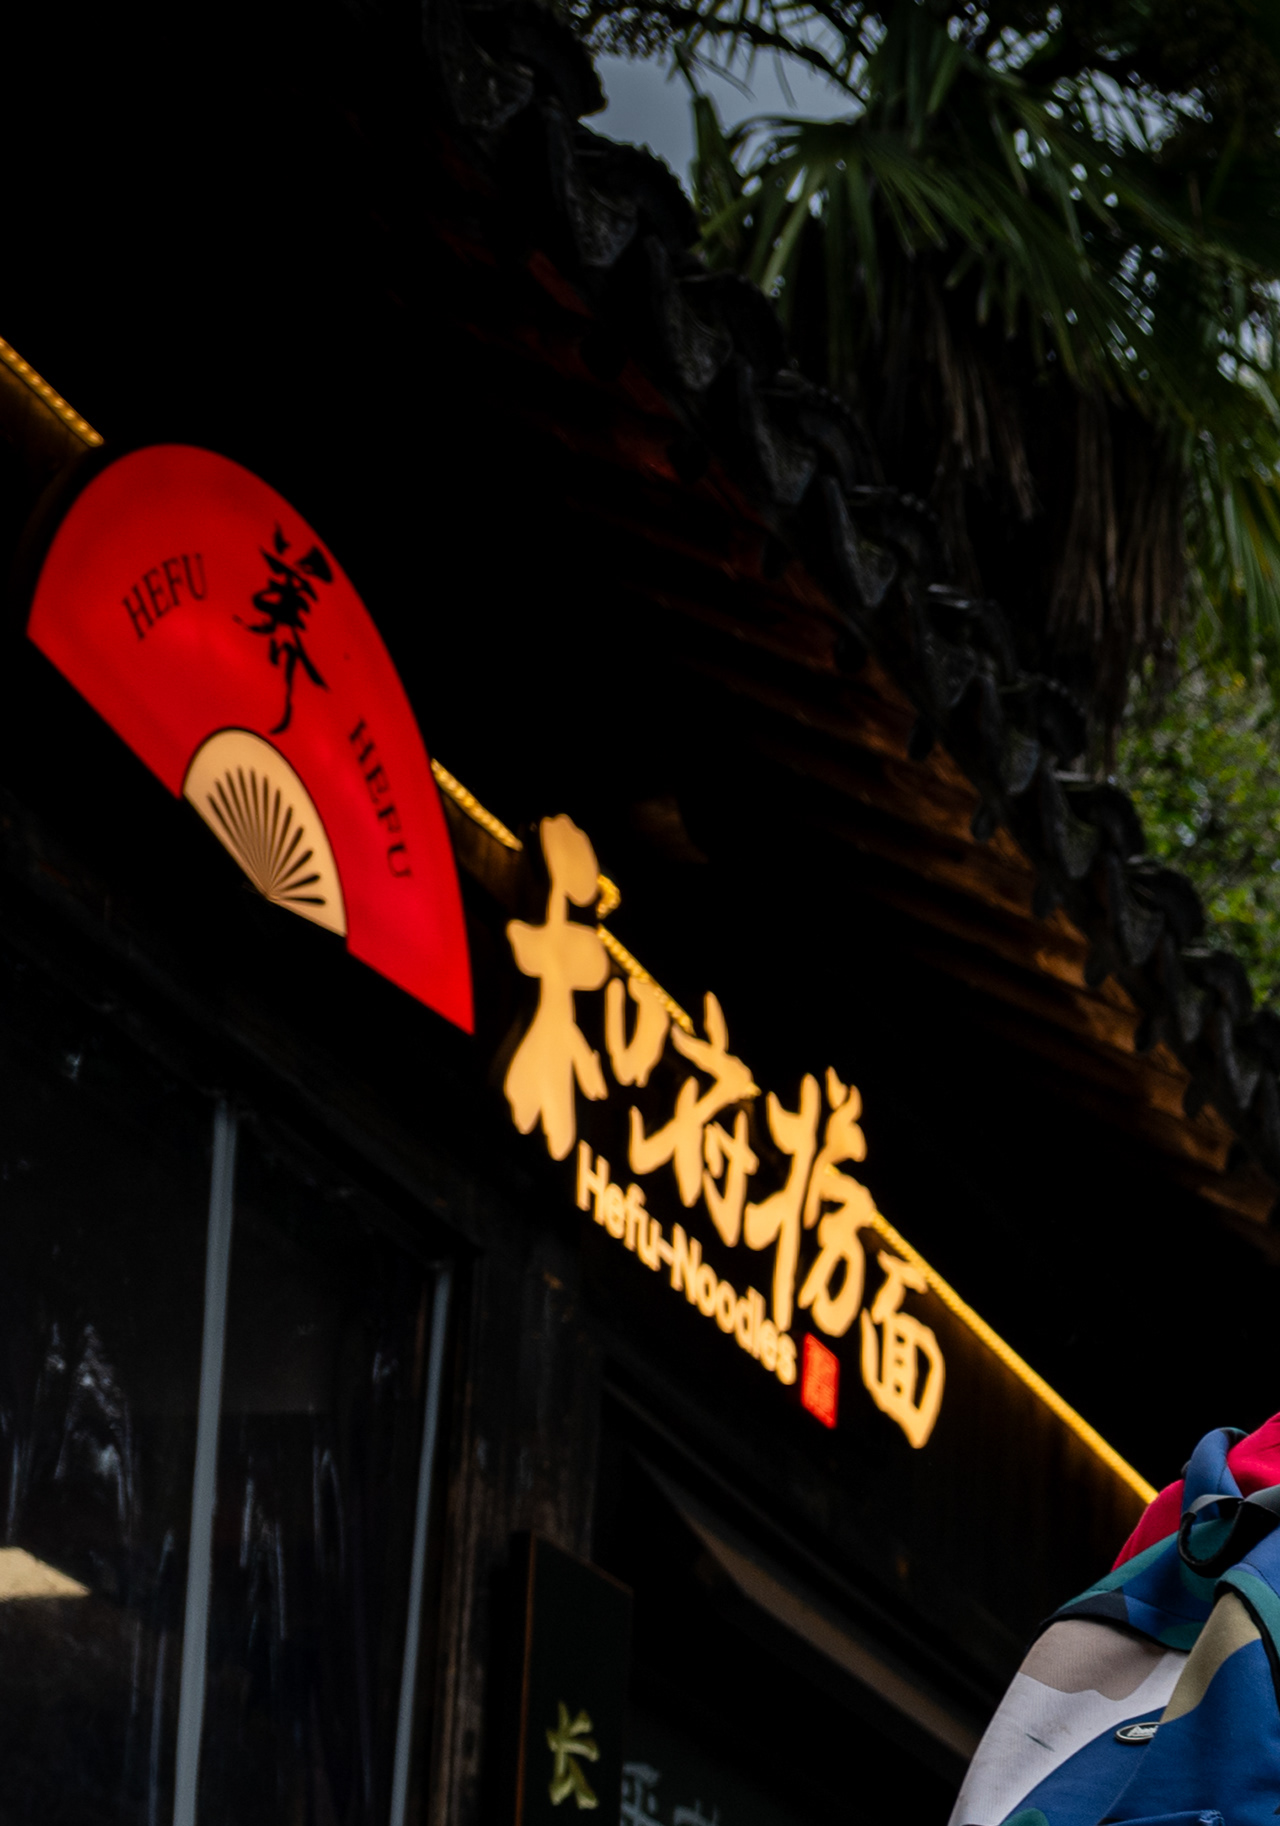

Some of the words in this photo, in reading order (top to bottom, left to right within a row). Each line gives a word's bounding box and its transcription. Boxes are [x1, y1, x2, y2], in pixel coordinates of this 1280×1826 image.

[121, 552, 207, 642] HEFU
[348, 718, 413, 880] HEFU
[503, 813, 946, 1448] 和府捞面
[576, 1140, 798, 1386] Hefu-Noodles
